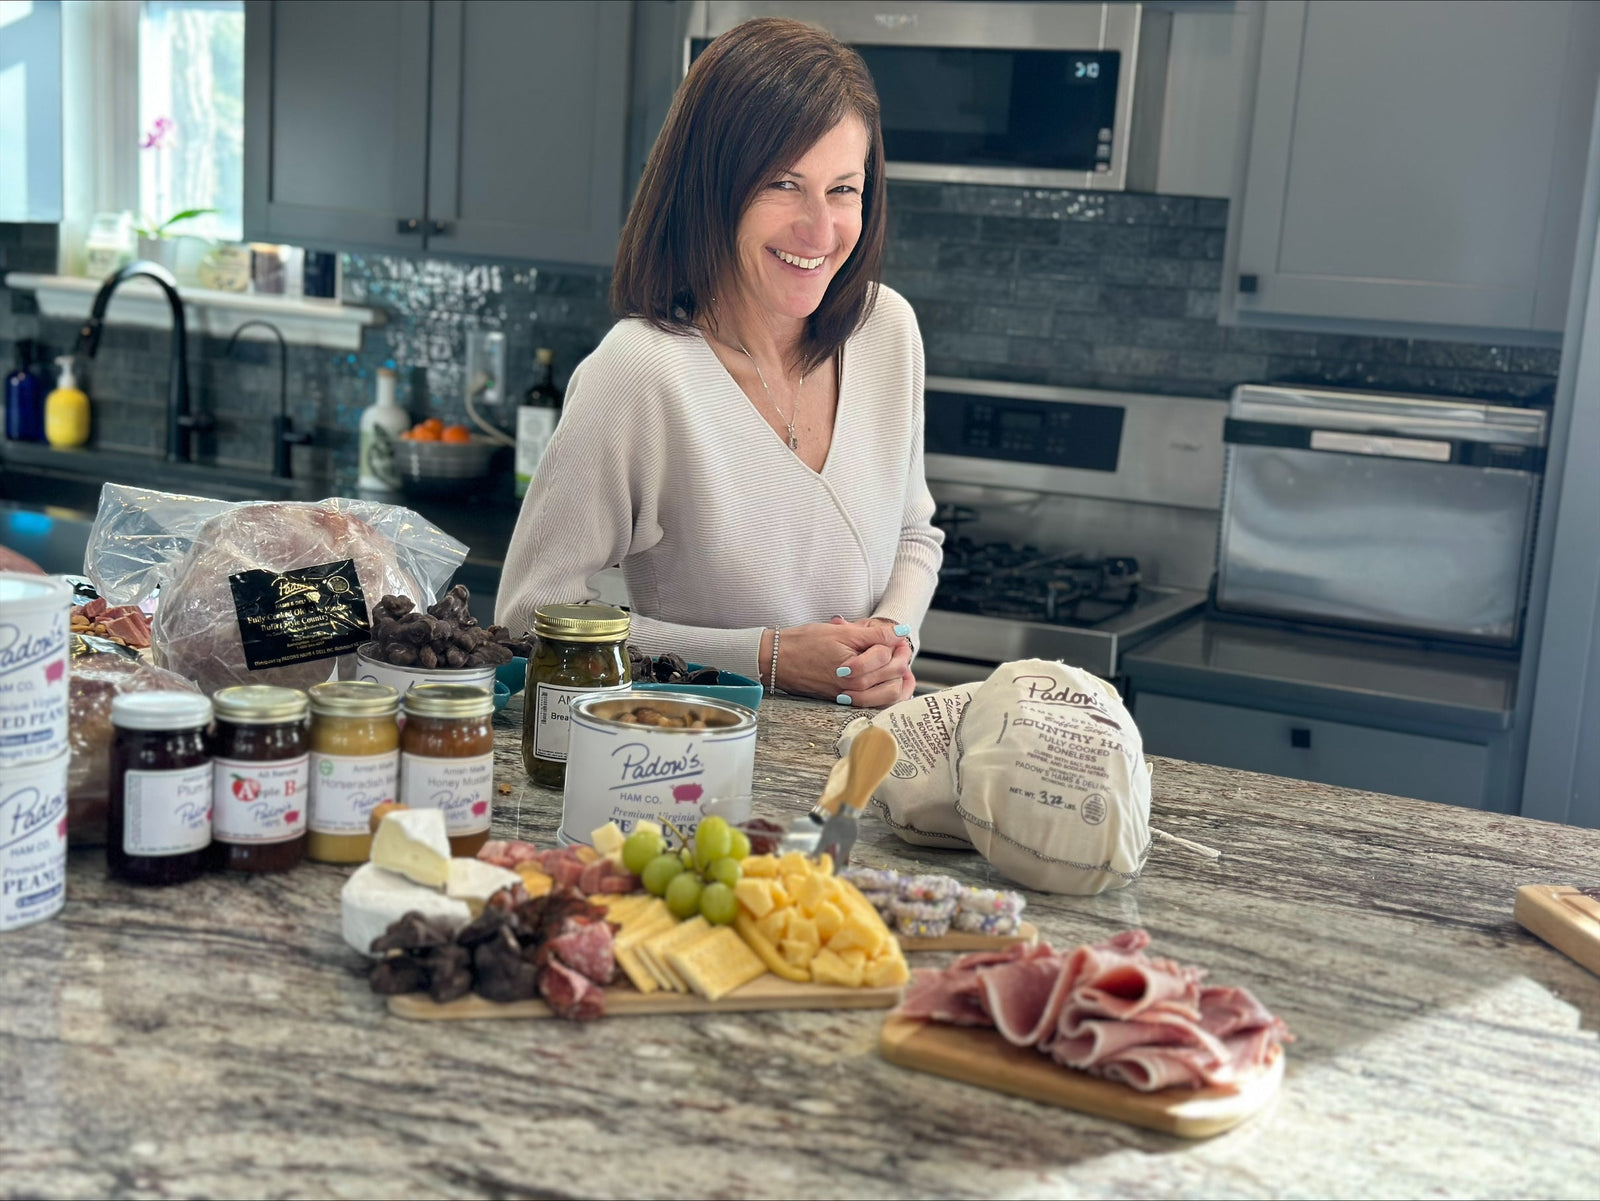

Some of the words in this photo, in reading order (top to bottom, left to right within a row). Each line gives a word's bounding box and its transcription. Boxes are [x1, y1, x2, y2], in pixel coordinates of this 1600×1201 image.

[916, 721, 941, 755] BONELESS
[1012, 718, 1095, 745] COUNTRY
[1039, 733, 1067, 748] FULLY
[1068, 743, 1110, 757] COOKED
[1047, 744, 1097, 763] BONELESS
[611, 742, 701, 780] Padow's
[428, 777, 460, 790] Honey
[1051, 770, 1074, 784] HAMS
[1082, 778, 1099, 789] DELI
[620, 792, 642, 803] HAM
[645, 795, 662, 805] CO.
[613, 806, 655, 820] Premium
